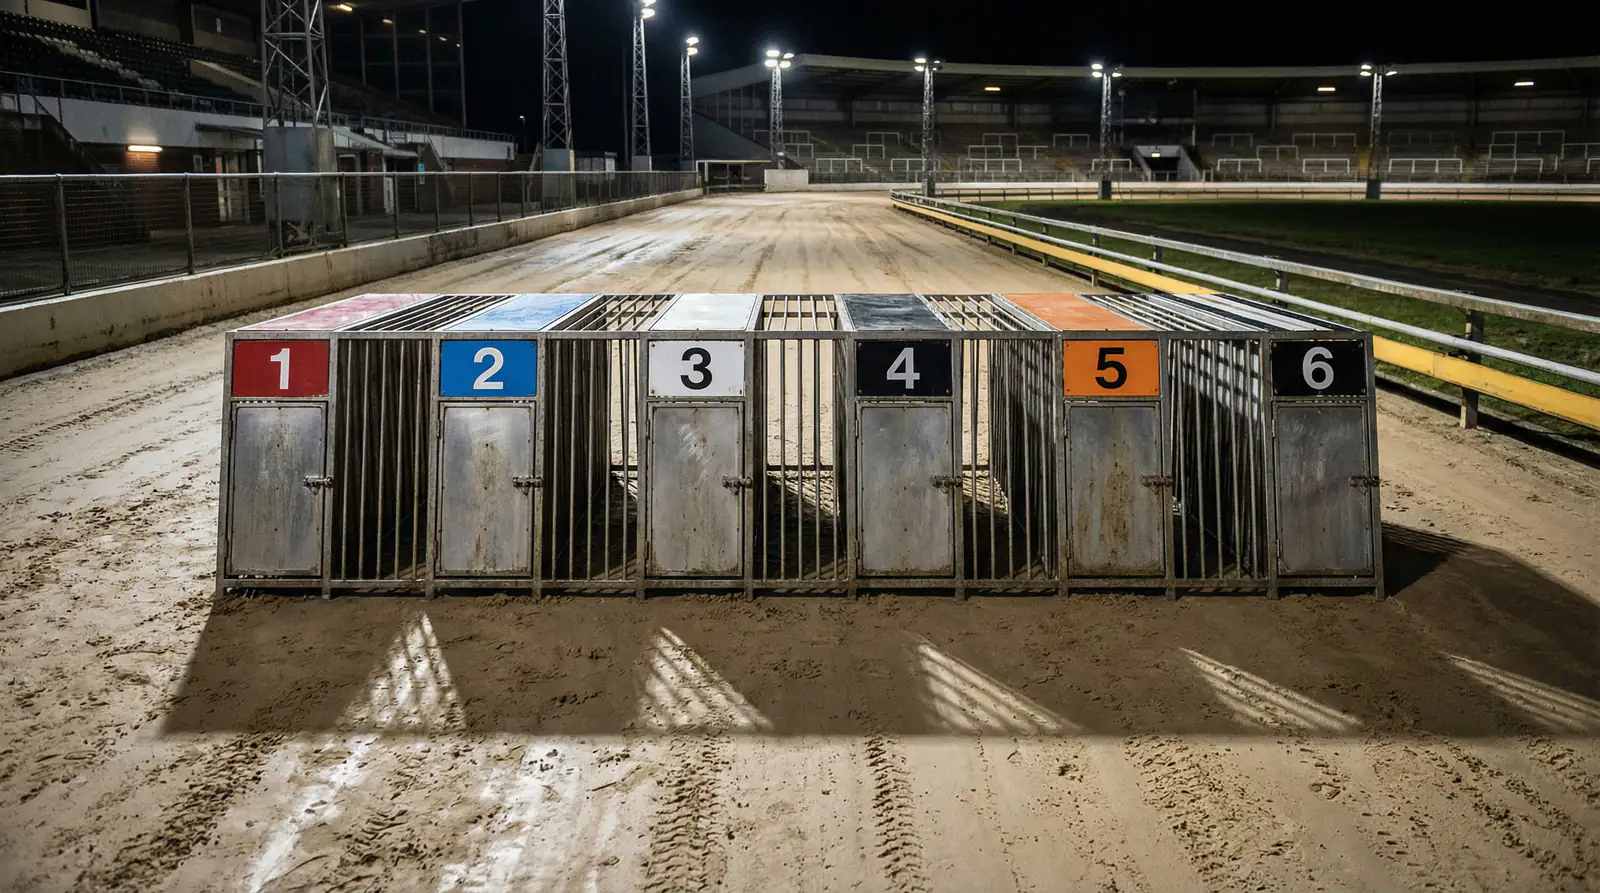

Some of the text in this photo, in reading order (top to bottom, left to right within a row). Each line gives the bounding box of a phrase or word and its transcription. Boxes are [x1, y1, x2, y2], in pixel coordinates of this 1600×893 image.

[270, 347, 290, 390] 1
[473, 347, 504, 390] 2
[680, 347, 713, 390] 3
[887, 347, 920, 389] 4
[1095, 347, 1128, 389] 5
[1302, 346, 1334, 390] 6
